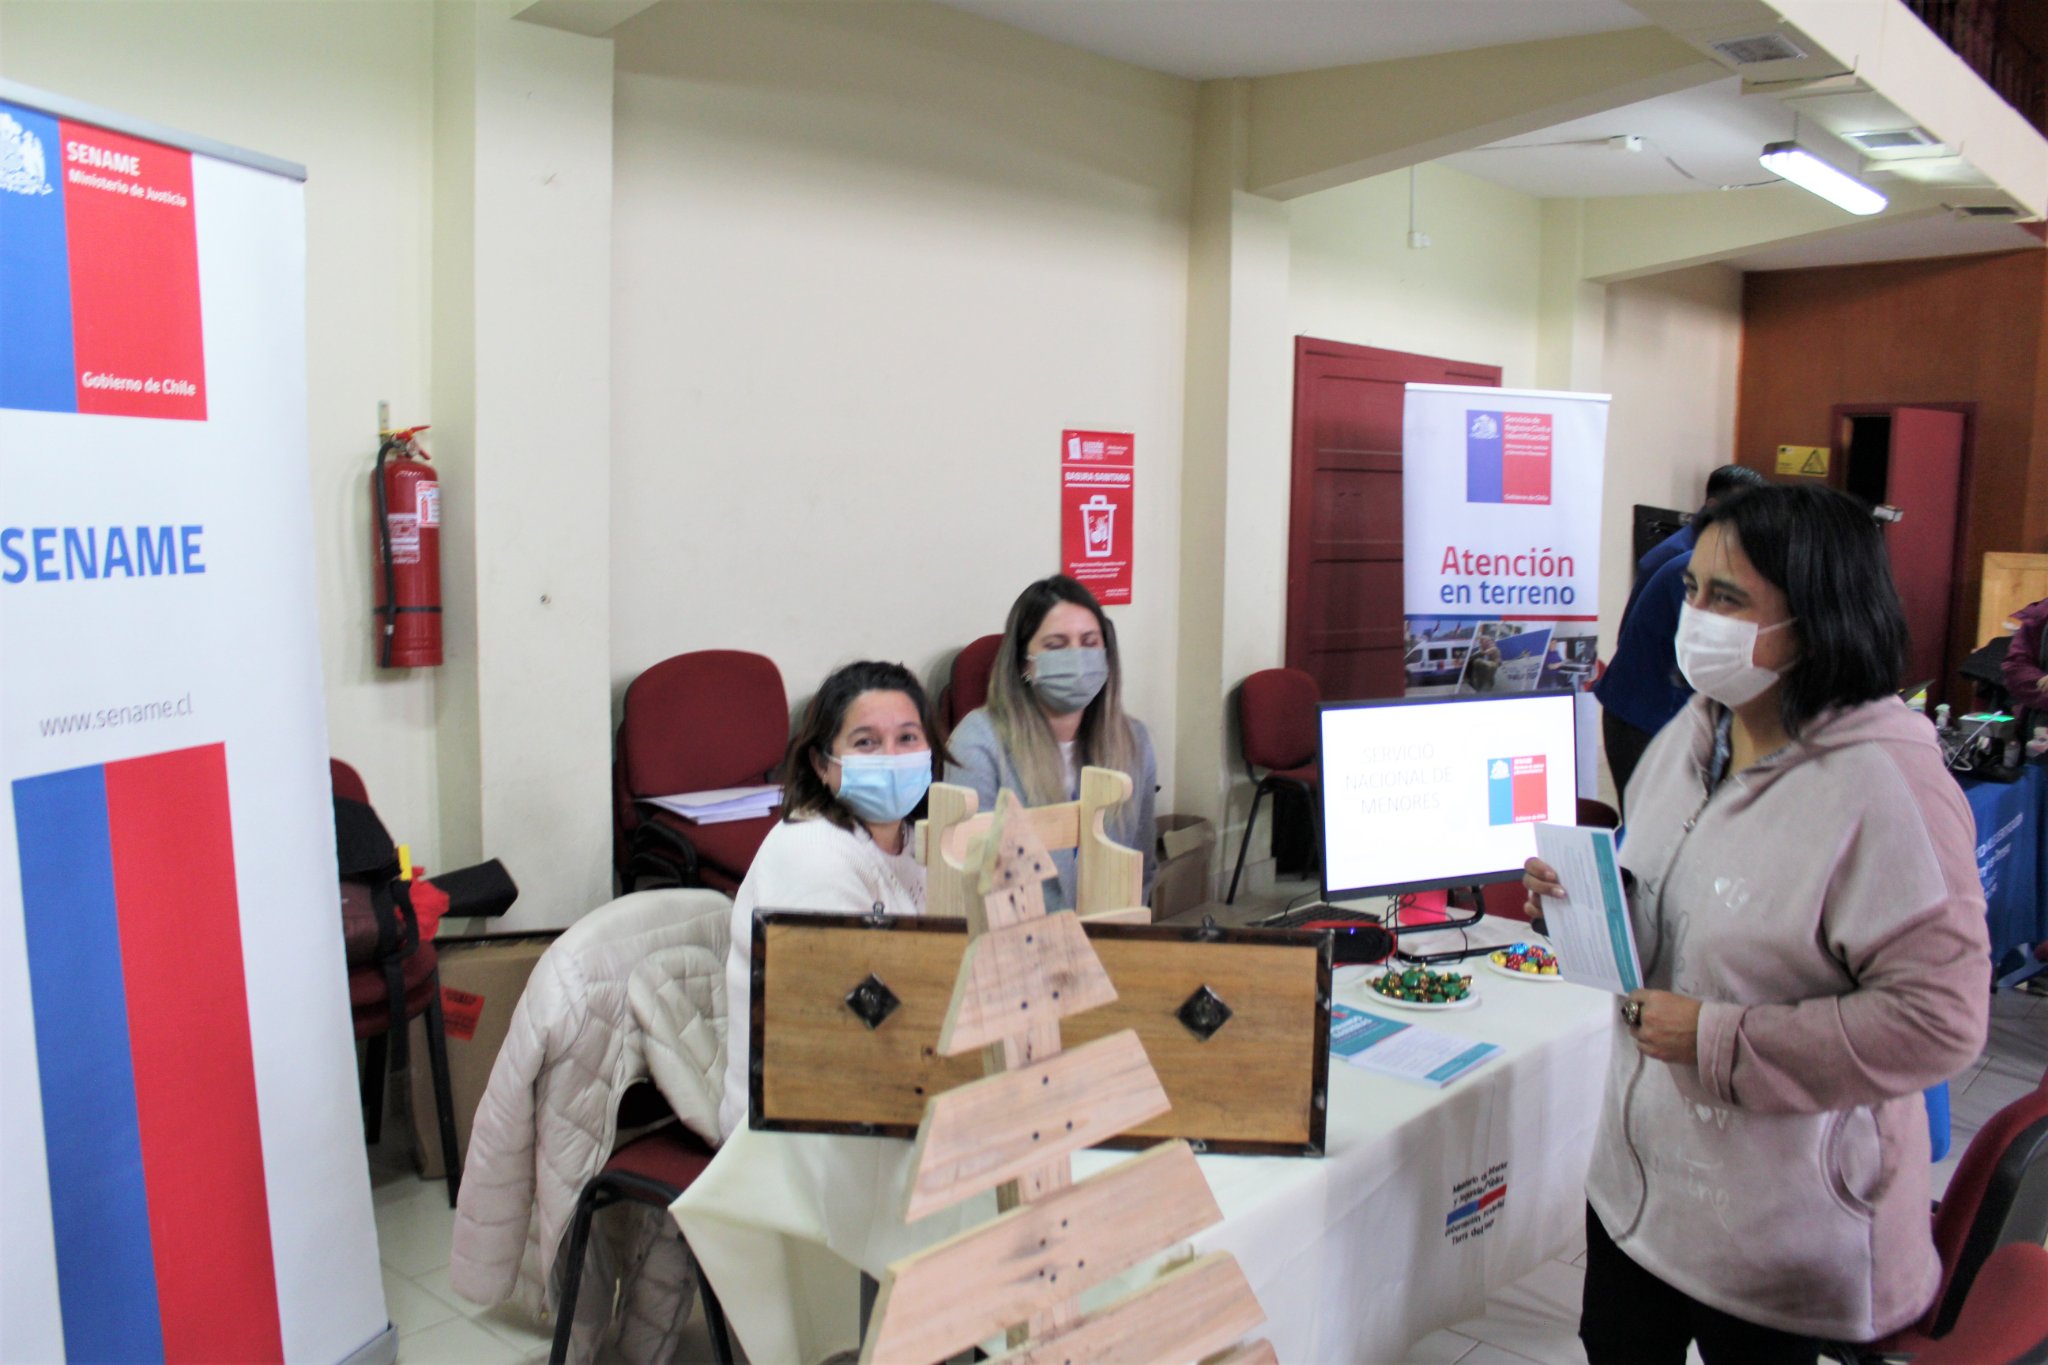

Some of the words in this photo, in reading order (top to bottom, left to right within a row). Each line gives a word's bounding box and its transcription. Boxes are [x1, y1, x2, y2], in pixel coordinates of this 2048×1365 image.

[67, 141, 141, 177] SENAME
[68, 168, 129, 195] Ministerio
[130, 183, 145, 198] de
[146, 186, 188, 208] Justicia
[82, 371, 143, 393] Gobierno
[144, 378, 161, 394] de
[162, 378, 197, 396] Chile
[0, 525, 206, 584] SENAME
[1441, 545, 1574, 577] Atención
[1440, 583, 1471, 605] en
[1480, 581, 1575, 605] terreno
[39, 692, 194, 738] www.sename.cl
[1361, 743, 1435, 765] SERVICIO
[1345, 767, 1430, 792] NACIONAL
[1433, 765, 1456, 785] DE
[1360, 792, 1441, 815] MENORES
